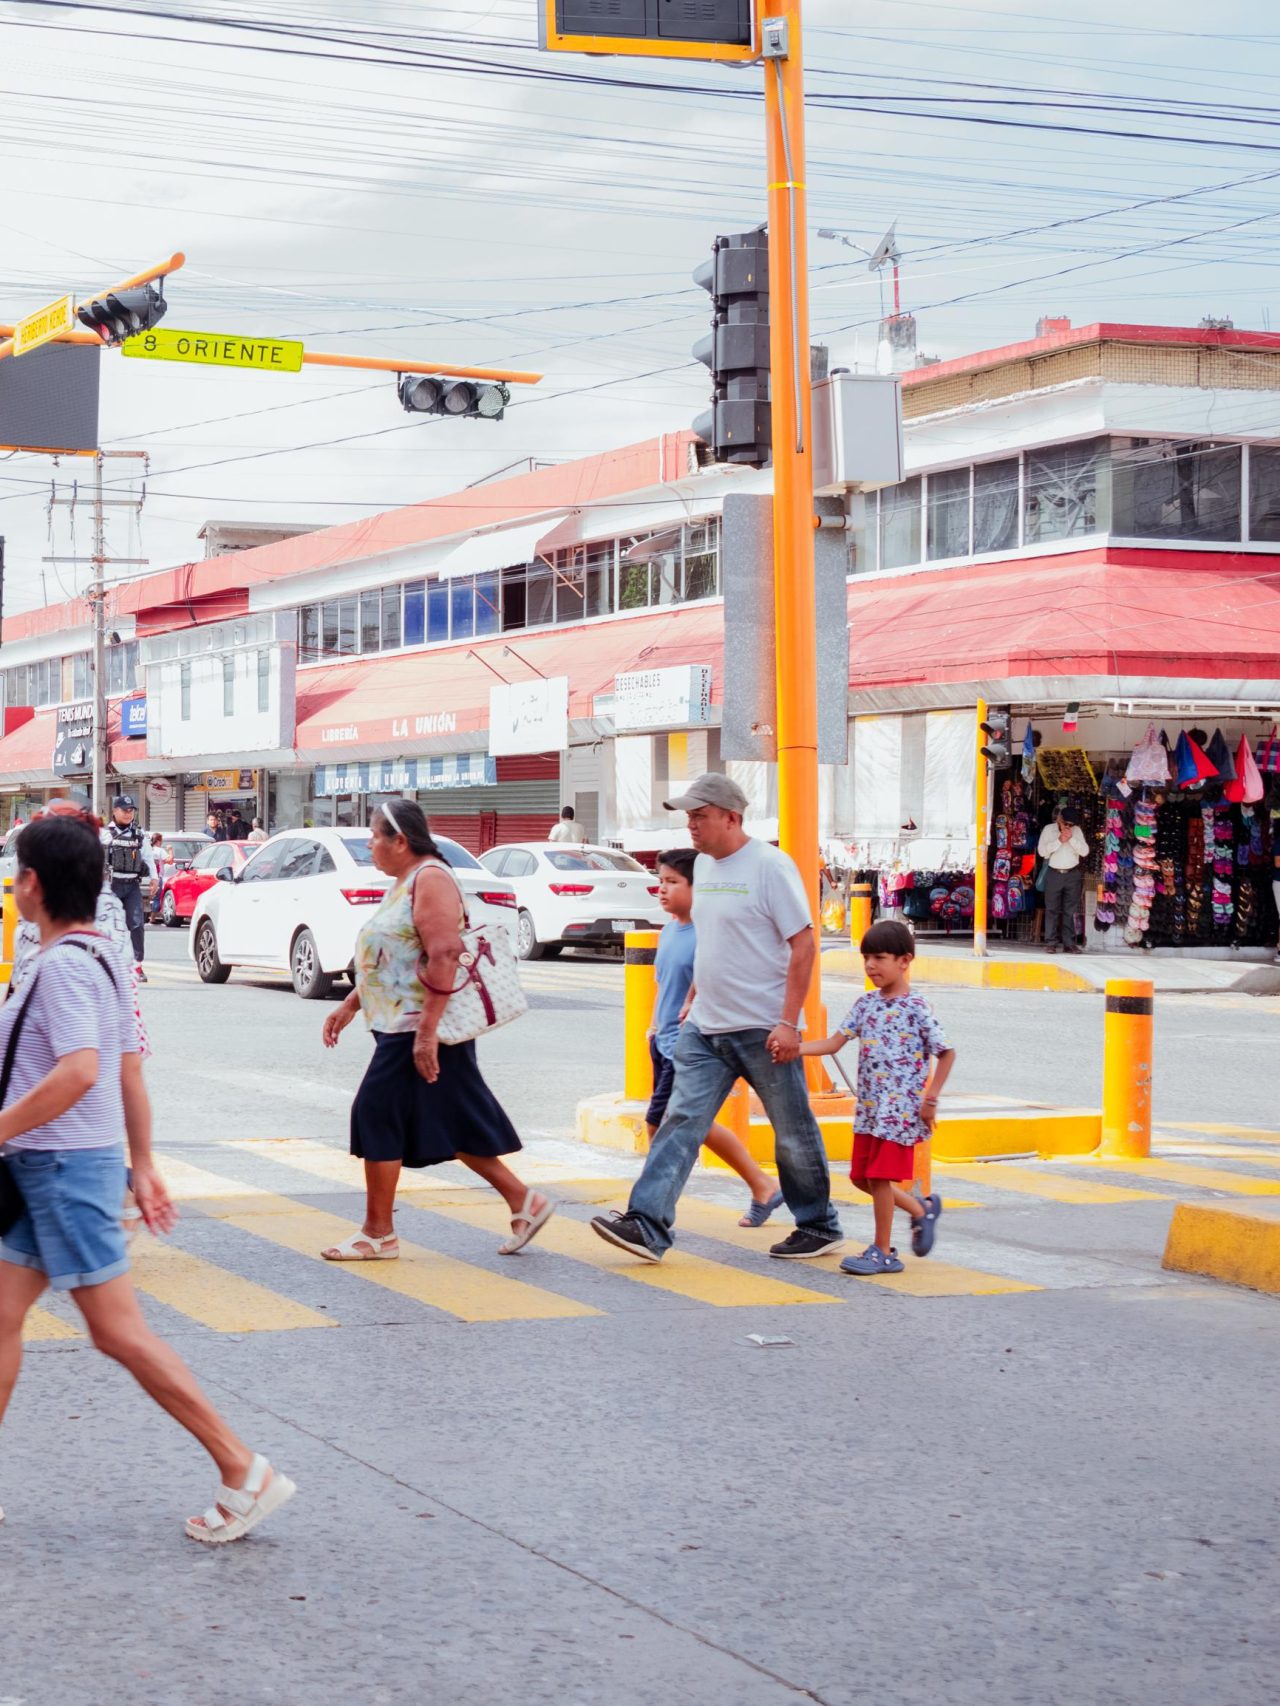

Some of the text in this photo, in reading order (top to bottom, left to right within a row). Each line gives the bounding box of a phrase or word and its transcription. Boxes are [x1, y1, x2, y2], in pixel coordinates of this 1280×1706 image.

[144, 335, 284, 364] 8 ORIENTE
[615, 673, 661, 691] DESECHABLES
[58, 705, 93, 722] TENIS MUND
[321, 711, 456, 742] LIBRERÍA LA UNIÓN
